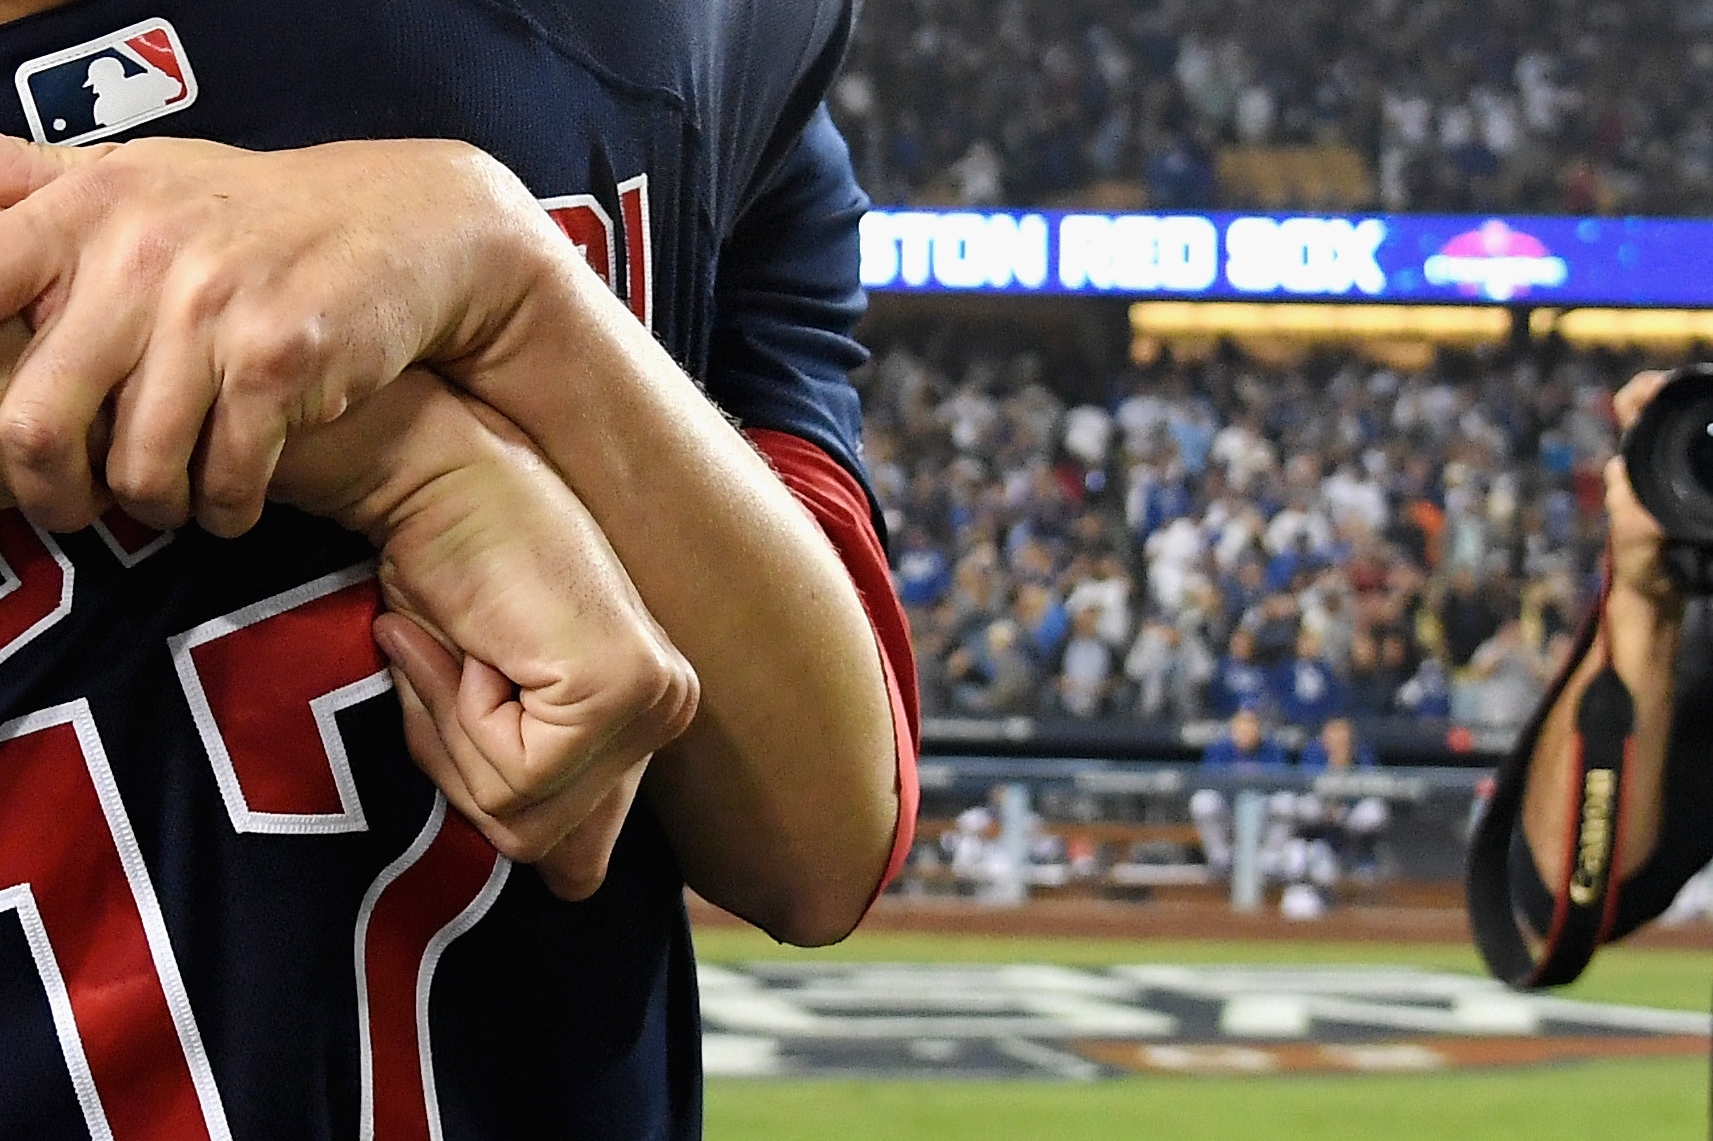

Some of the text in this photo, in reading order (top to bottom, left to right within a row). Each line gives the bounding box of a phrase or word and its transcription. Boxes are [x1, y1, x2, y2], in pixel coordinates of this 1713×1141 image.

[859, 211, 1047, 287] STON
[1059, 215, 1217, 289] RED
[1226, 218, 1386, 294] SOX
